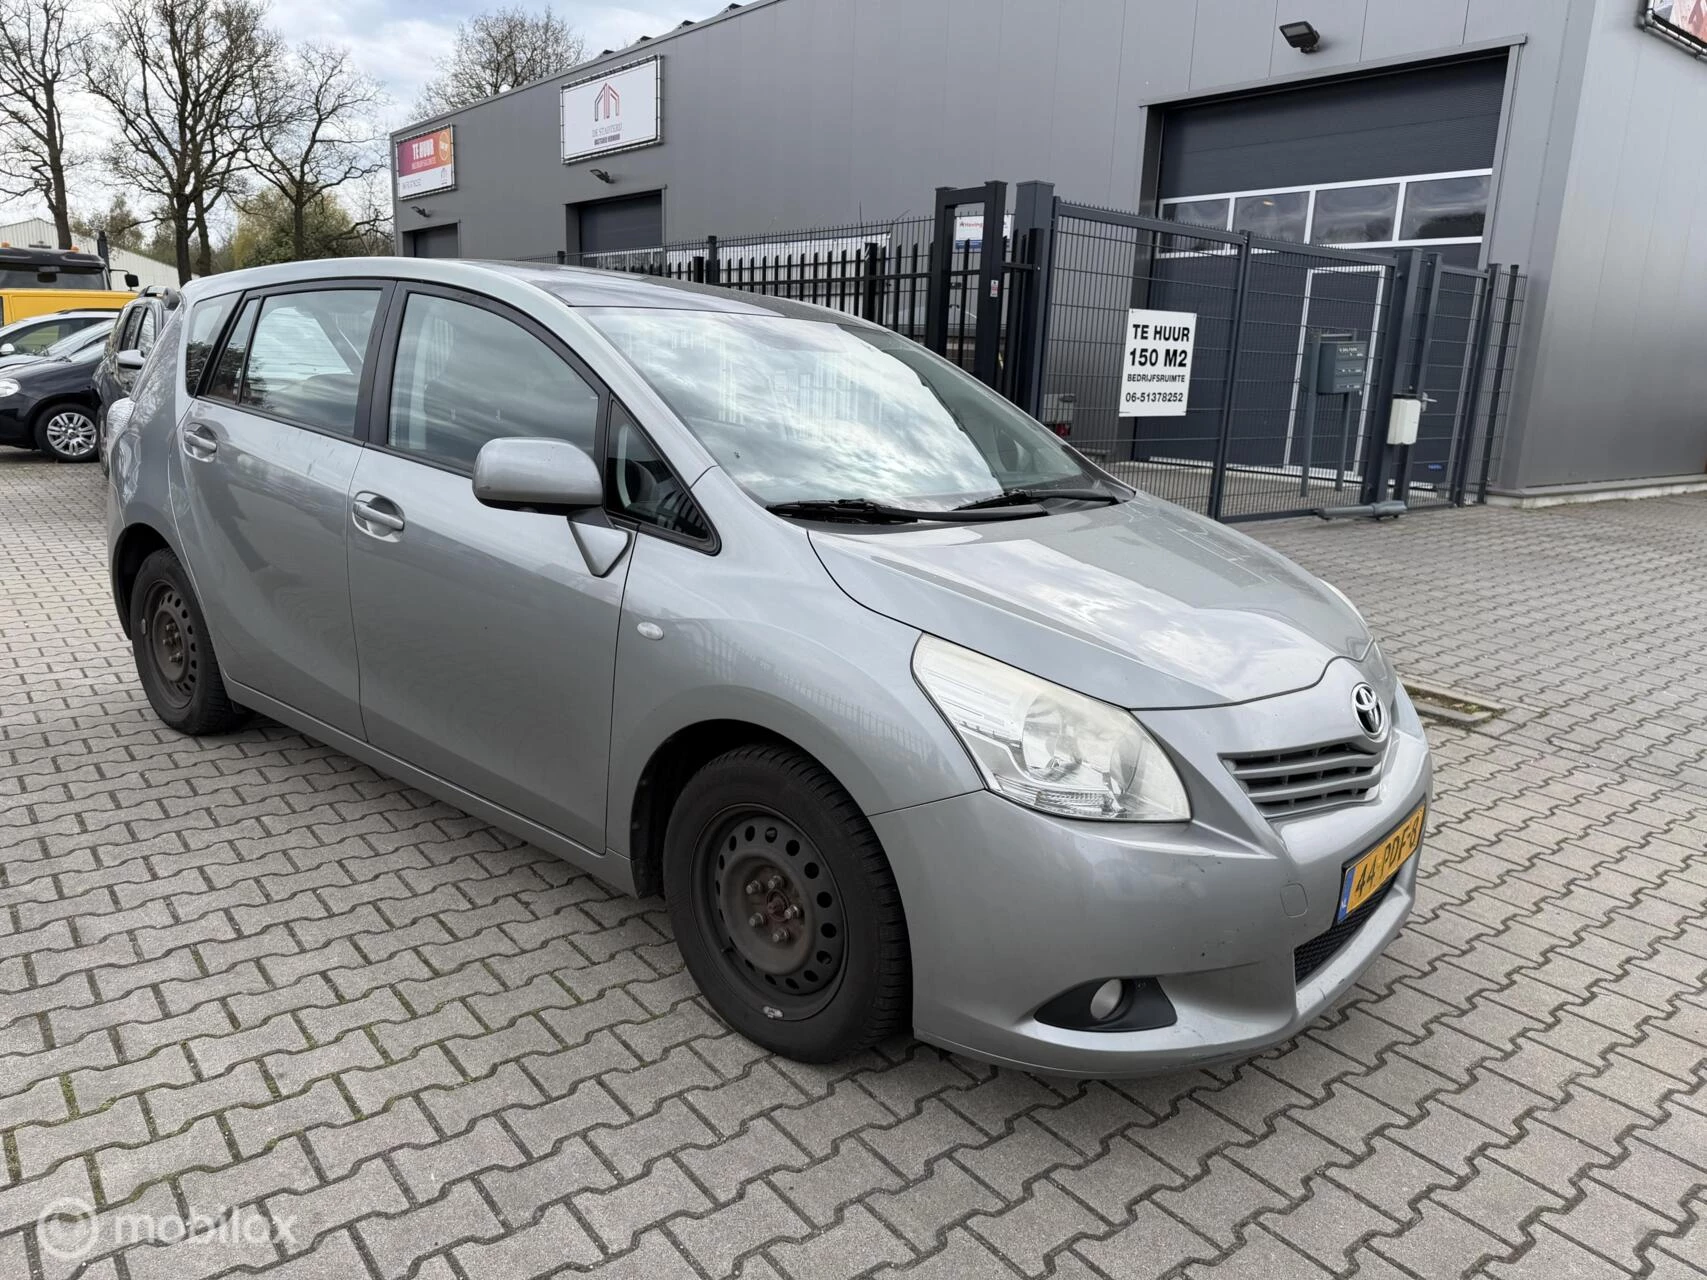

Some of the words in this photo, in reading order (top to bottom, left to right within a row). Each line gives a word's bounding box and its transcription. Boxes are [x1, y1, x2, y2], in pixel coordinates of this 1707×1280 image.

[1132, 324, 1149, 340] TE
[1153, 325, 1190, 342] HUUR
[1129, 348, 1159, 366] 150
[1164, 349, 1188, 367] M2
[1127, 373, 1186, 383] BEDRIJFSRUIMTE
[1125, 392, 1184, 402] 06-51378252
